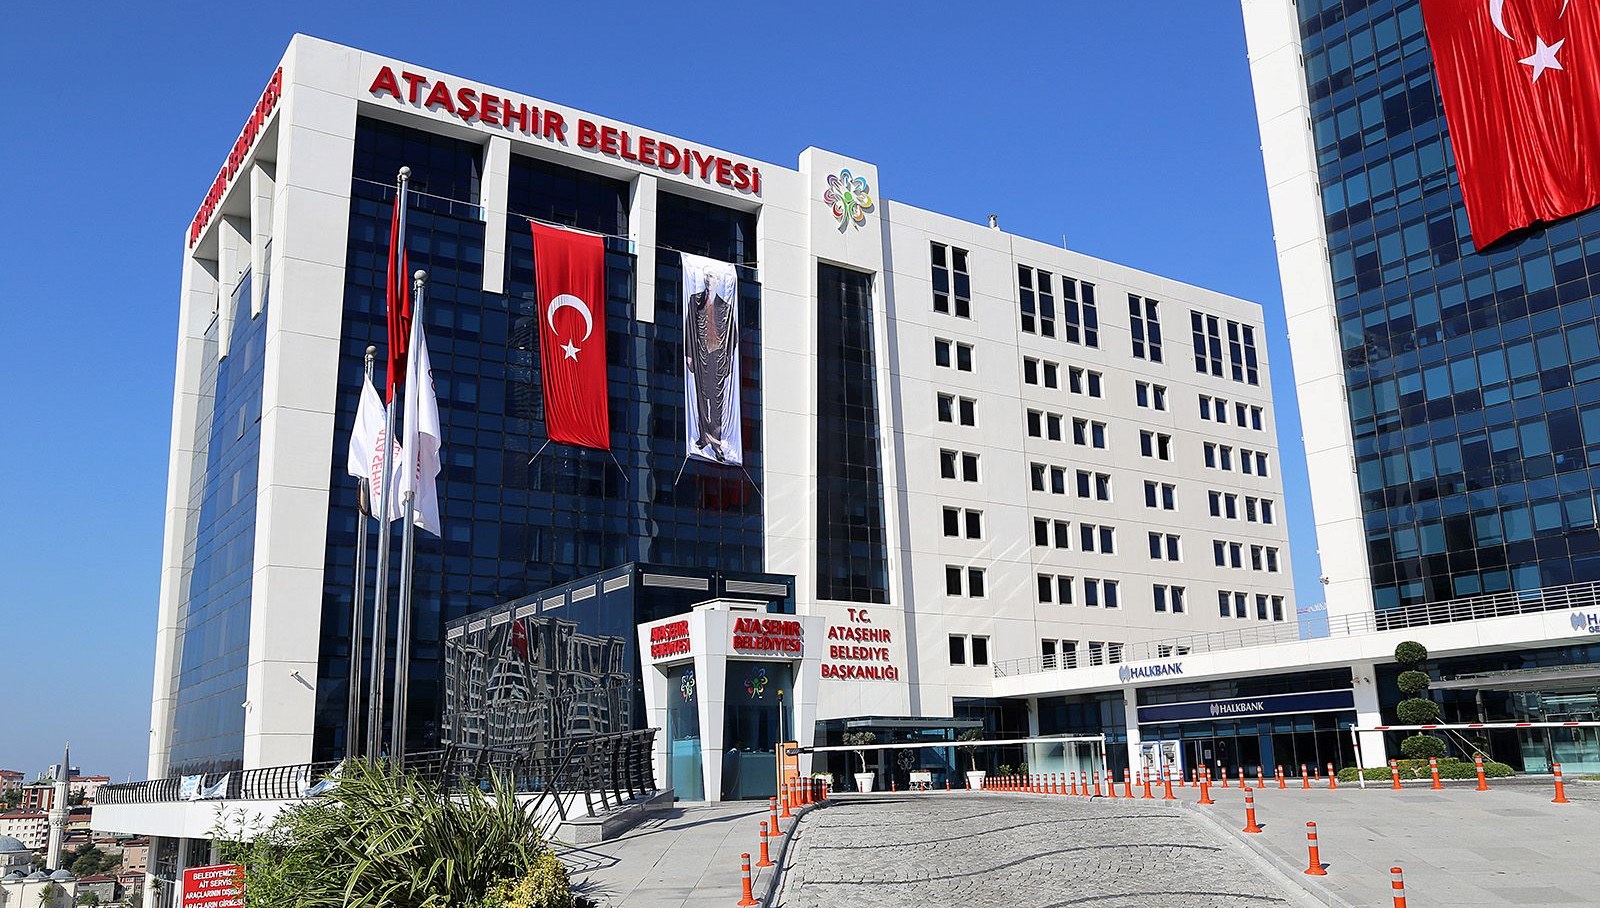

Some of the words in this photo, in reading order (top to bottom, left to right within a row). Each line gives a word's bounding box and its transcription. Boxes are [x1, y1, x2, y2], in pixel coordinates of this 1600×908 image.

[368, 65, 565, 143] ATAŞEHİR
[577, 118, 760, 194] BELEDİYESİ
[847, 608, 871, 623] T.C.
[821, 664, 899, 681] BAŞKANLIĞI
[1130, 662, 1183, 678] HALKBANK
[1219, 701, 1264, 714] HALKBANK
